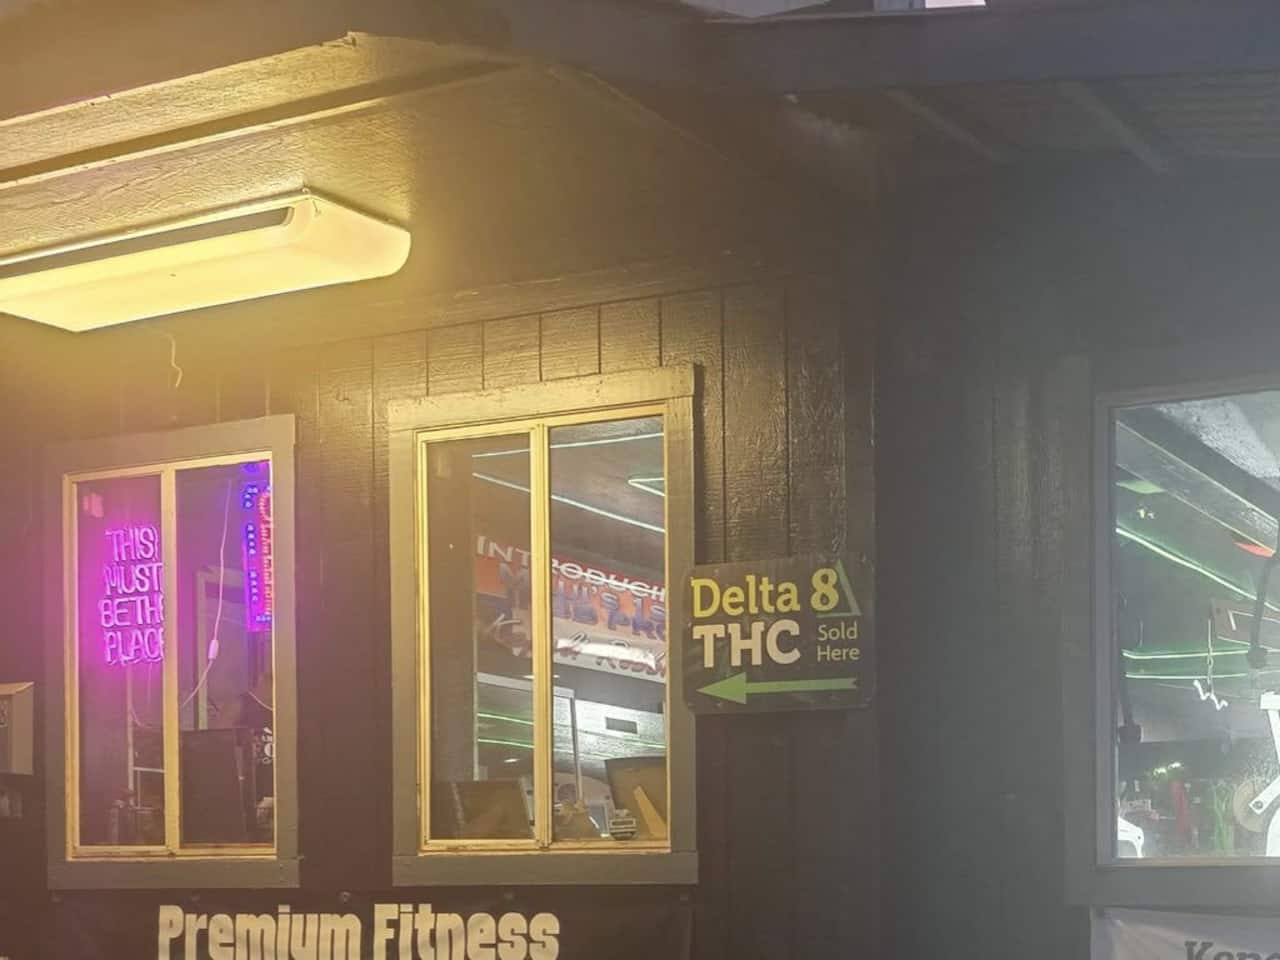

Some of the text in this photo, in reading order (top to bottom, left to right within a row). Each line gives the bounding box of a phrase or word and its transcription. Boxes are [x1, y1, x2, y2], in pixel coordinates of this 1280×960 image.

[105, 527, 157, 562] THIS
[104, 562, 164, 596] MUST
[691, 568, 839, 618] Delta 8
[692, 619, 801, 668] THC
[818, 621, 858, 642] Sold
[817, 644, 861, 662] Here
